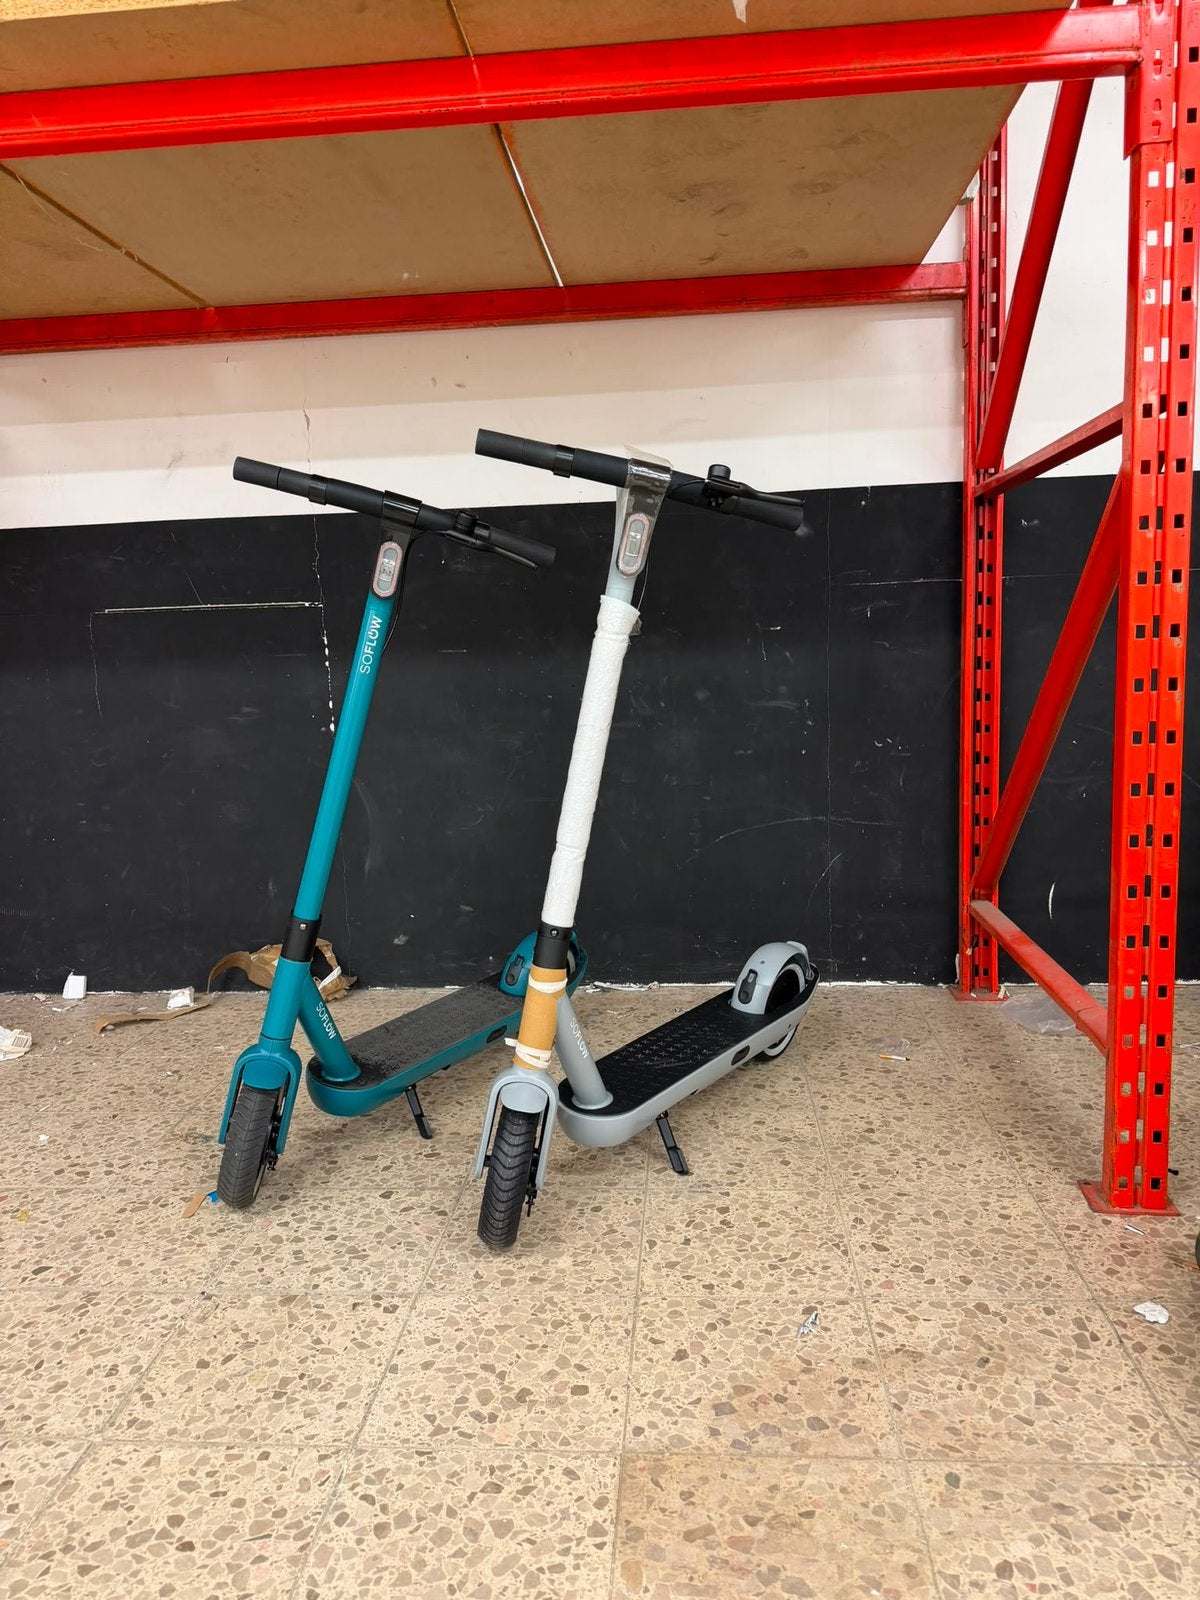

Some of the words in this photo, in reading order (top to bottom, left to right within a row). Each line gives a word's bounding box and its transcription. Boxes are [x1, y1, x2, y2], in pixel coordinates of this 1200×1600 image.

[360, 616, 382, 674] SOFLOW
[316, 1002, 336, 1039] SOFLOW
[570, 1017, 589, 1058] SOFLOW
